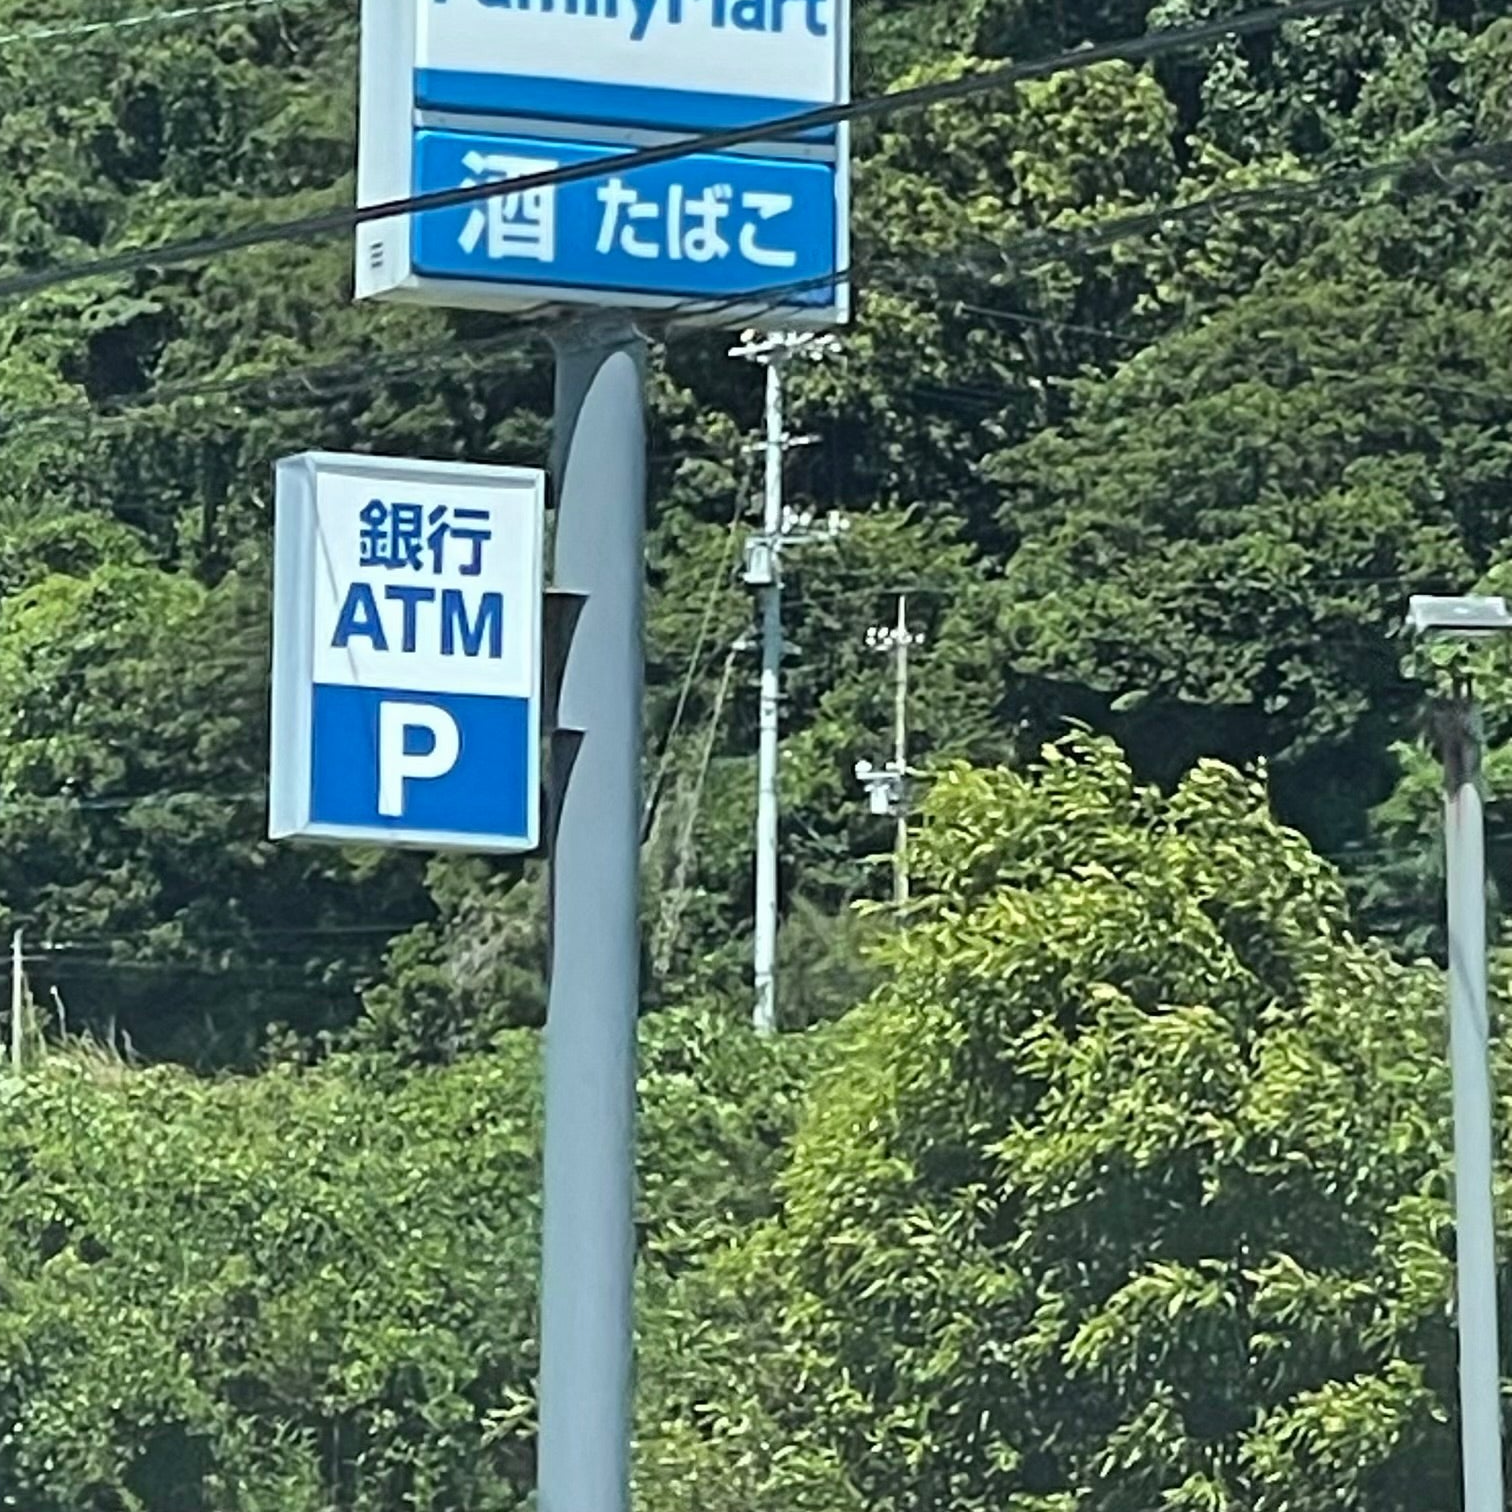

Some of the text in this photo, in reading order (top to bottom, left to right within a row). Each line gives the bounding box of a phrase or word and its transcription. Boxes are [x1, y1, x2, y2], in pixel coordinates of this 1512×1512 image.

[457, 150, 797, 267] 酒 たばこ
[359, 499, 492, 576] 銀行
[330, 581, 504, 659] ATM
[378, 700, 461, 817] P
